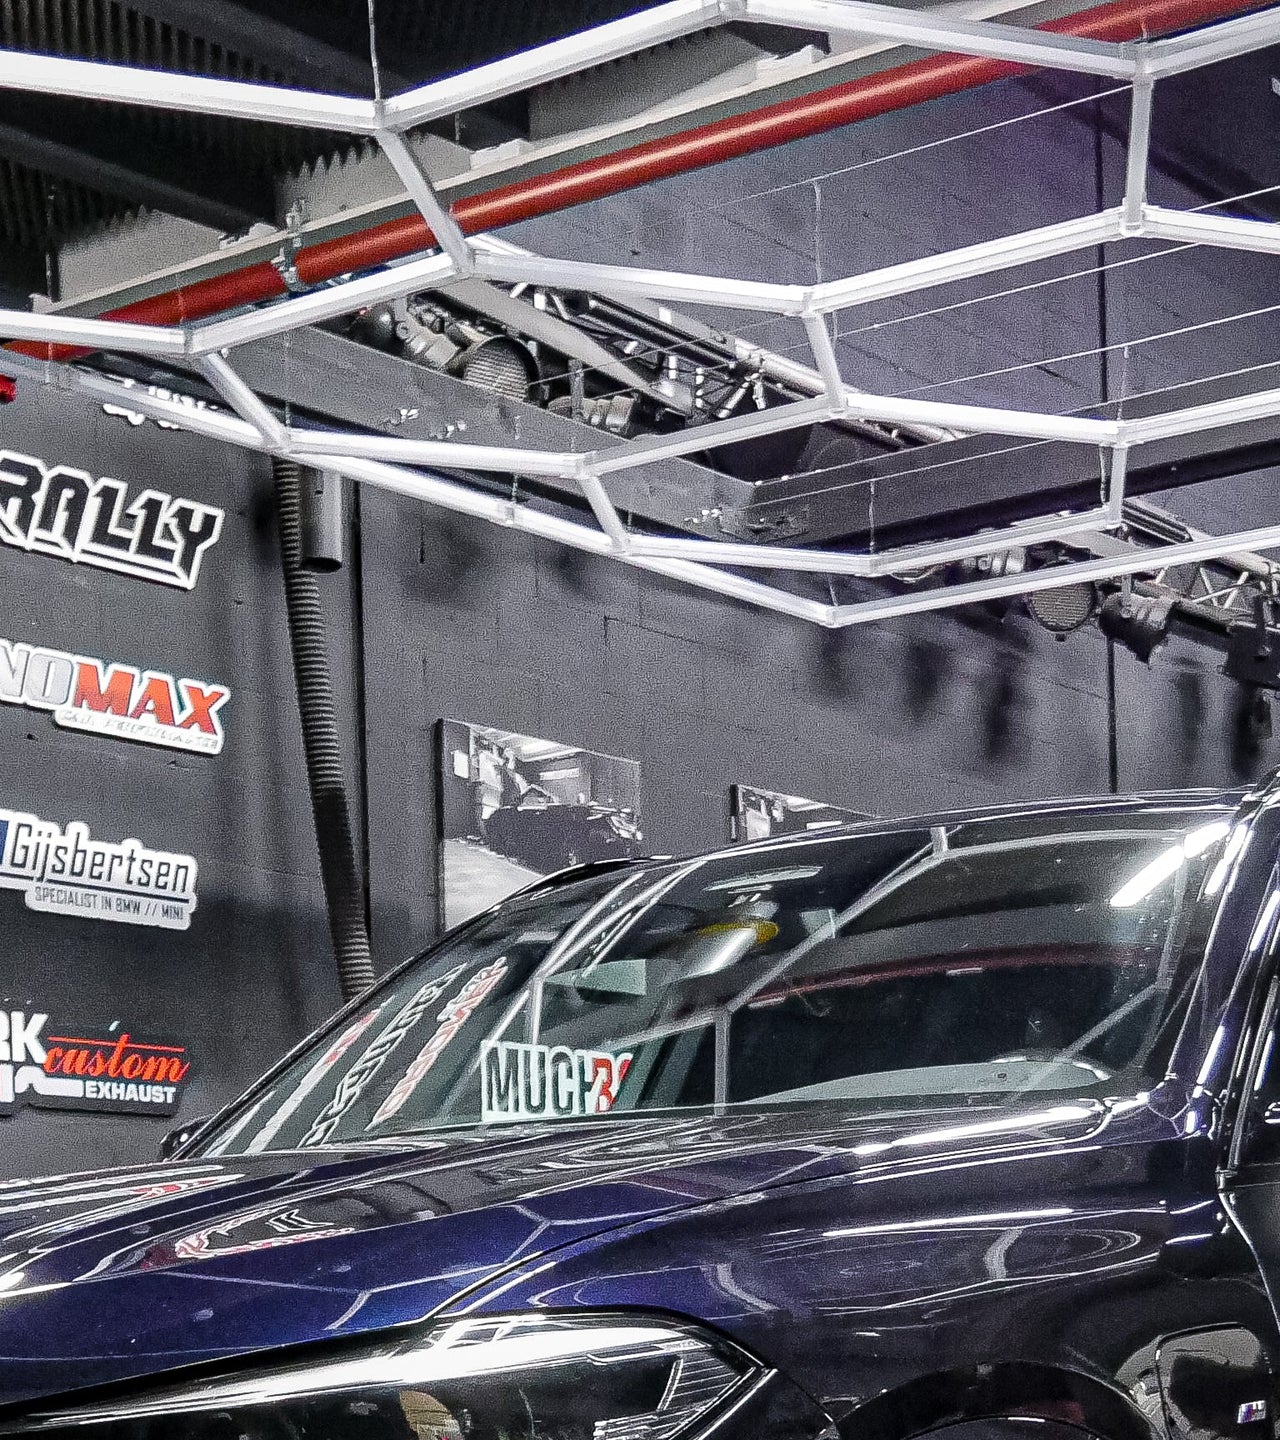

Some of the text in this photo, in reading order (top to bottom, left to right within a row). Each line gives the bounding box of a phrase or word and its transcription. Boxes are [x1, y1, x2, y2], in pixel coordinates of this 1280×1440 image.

[10, 822, 190, 894] Gijsbertsen
[35, 886, 98, 909] SPECIALIST
[101, 895, 112, 910] IN
[116, 898, 141, 916] BMW
[161, 904, 184, 920] MINI
[43, 1032, 190, 1083] custom
[85, 1080, 177, 1104] EXHAUST
